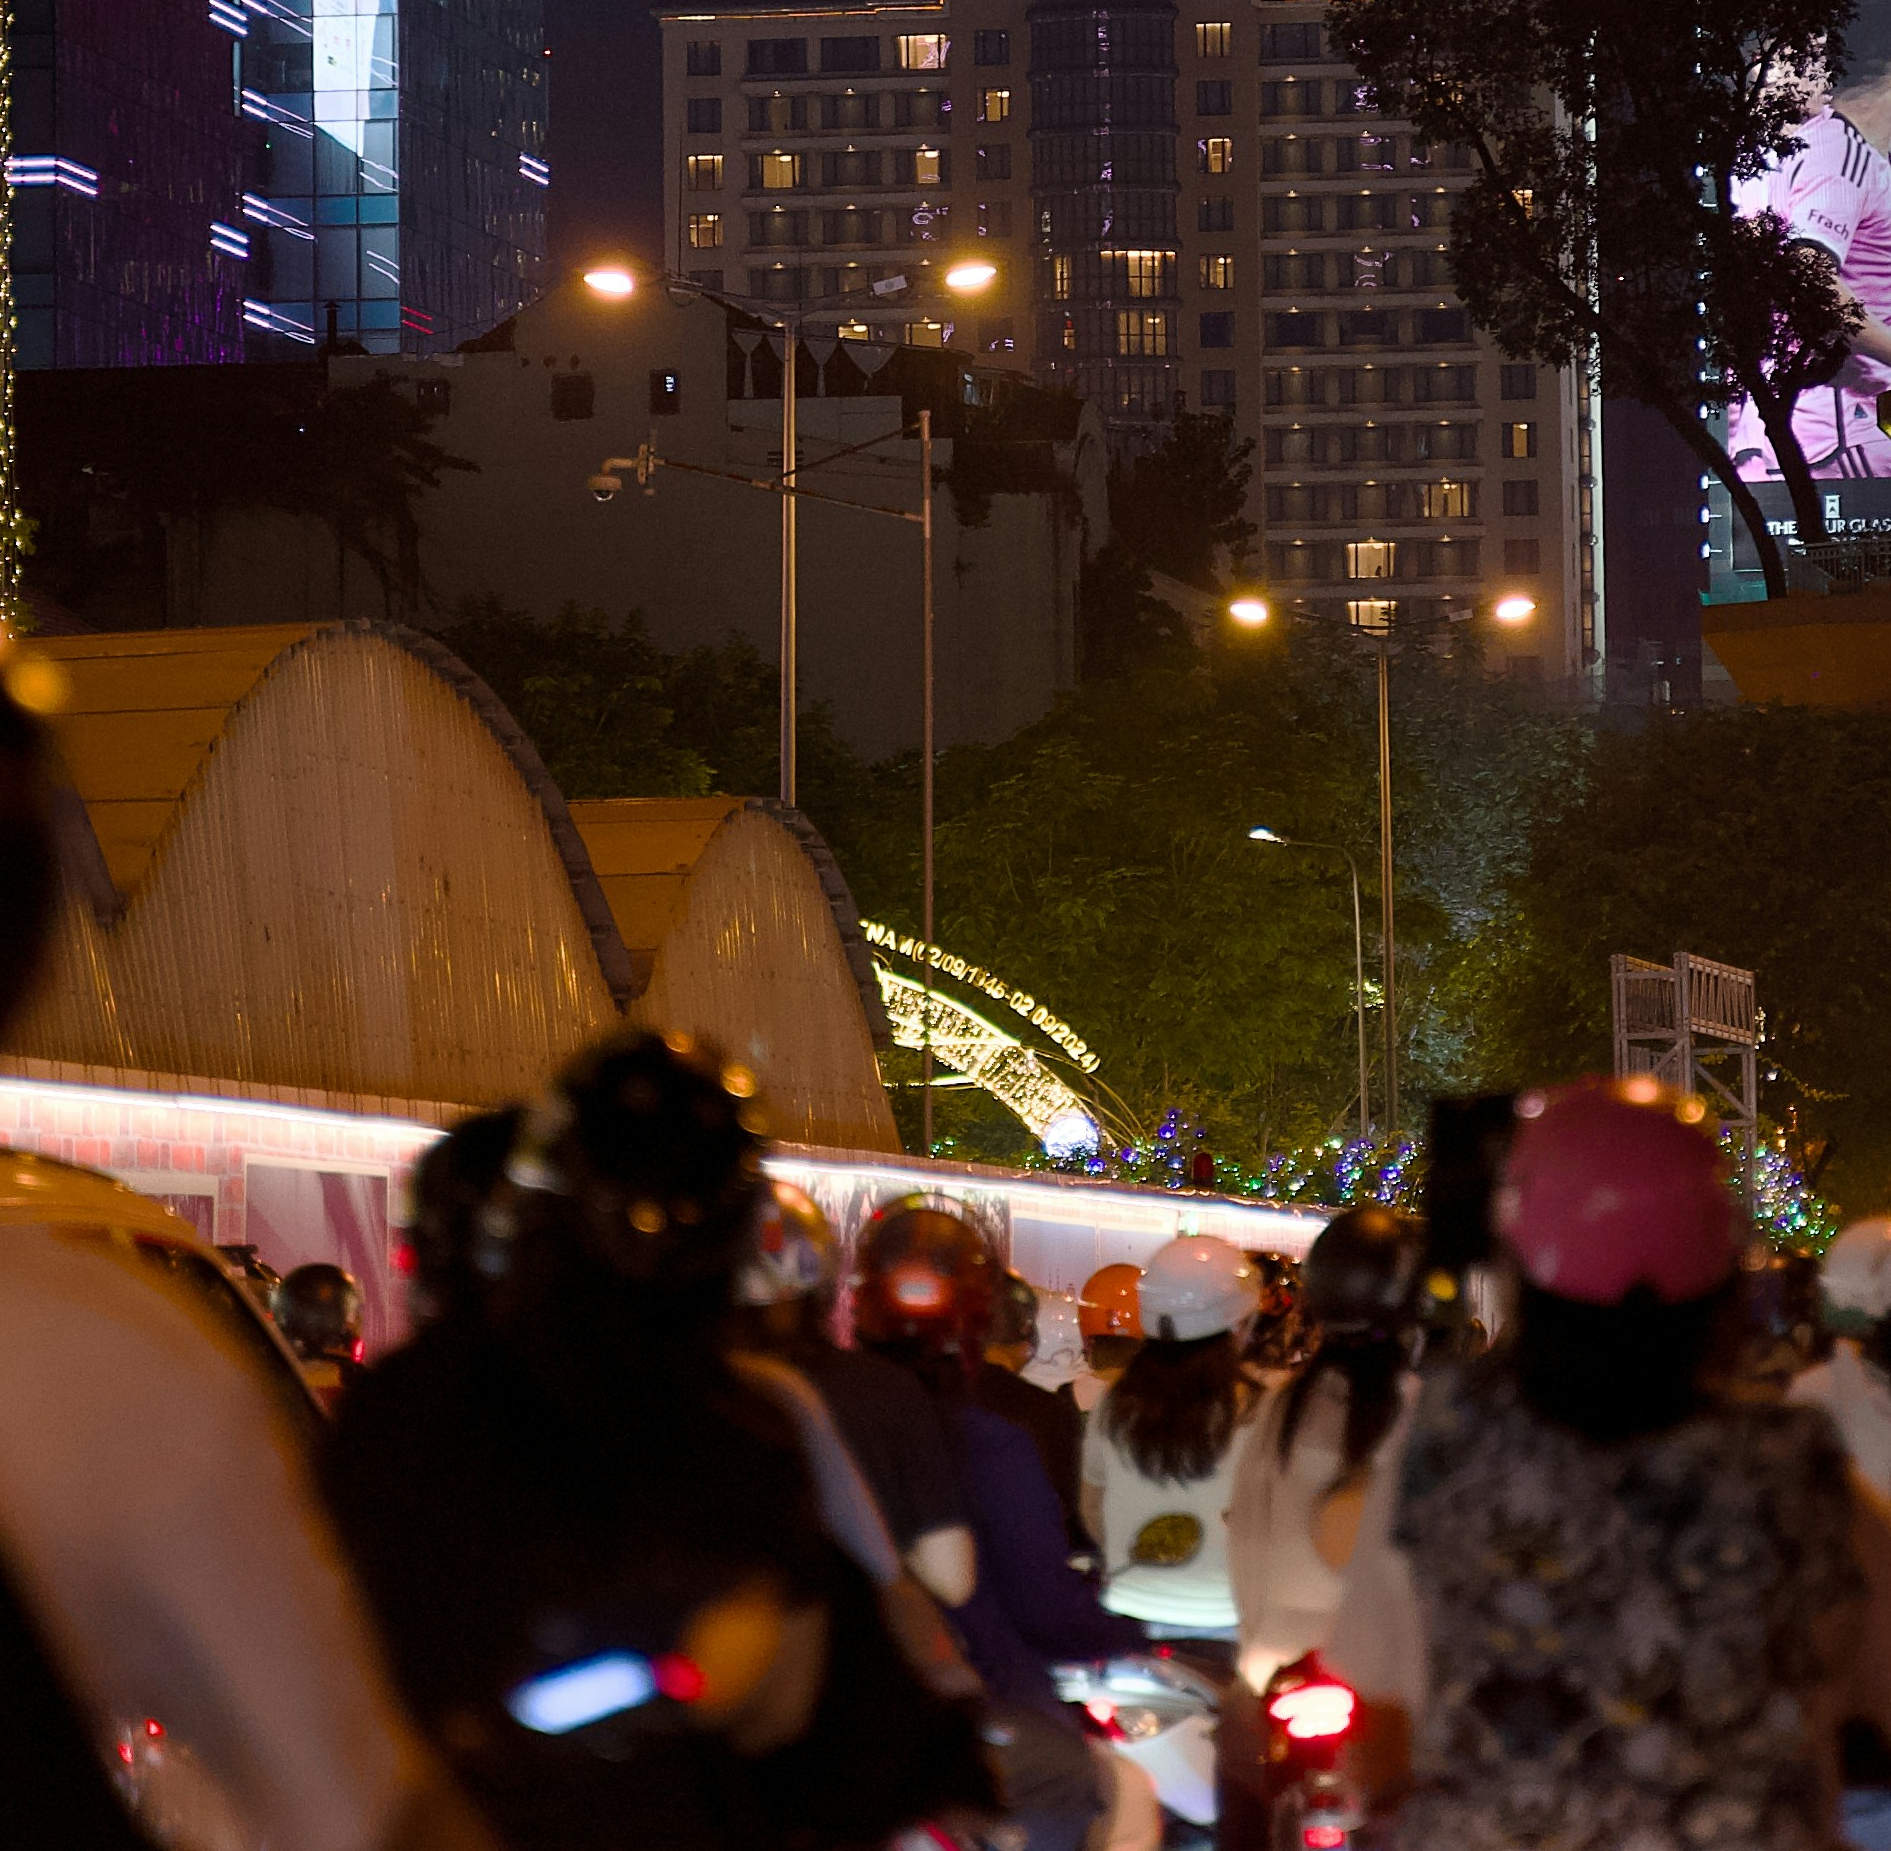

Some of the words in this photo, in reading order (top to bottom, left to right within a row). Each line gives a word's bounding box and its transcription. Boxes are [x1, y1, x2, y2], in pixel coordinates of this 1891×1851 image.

[1808, 209, 1849, 240] Frach
[1767, 520, 1798, 536] THE
[1825, 518, 1846, 534] UR
